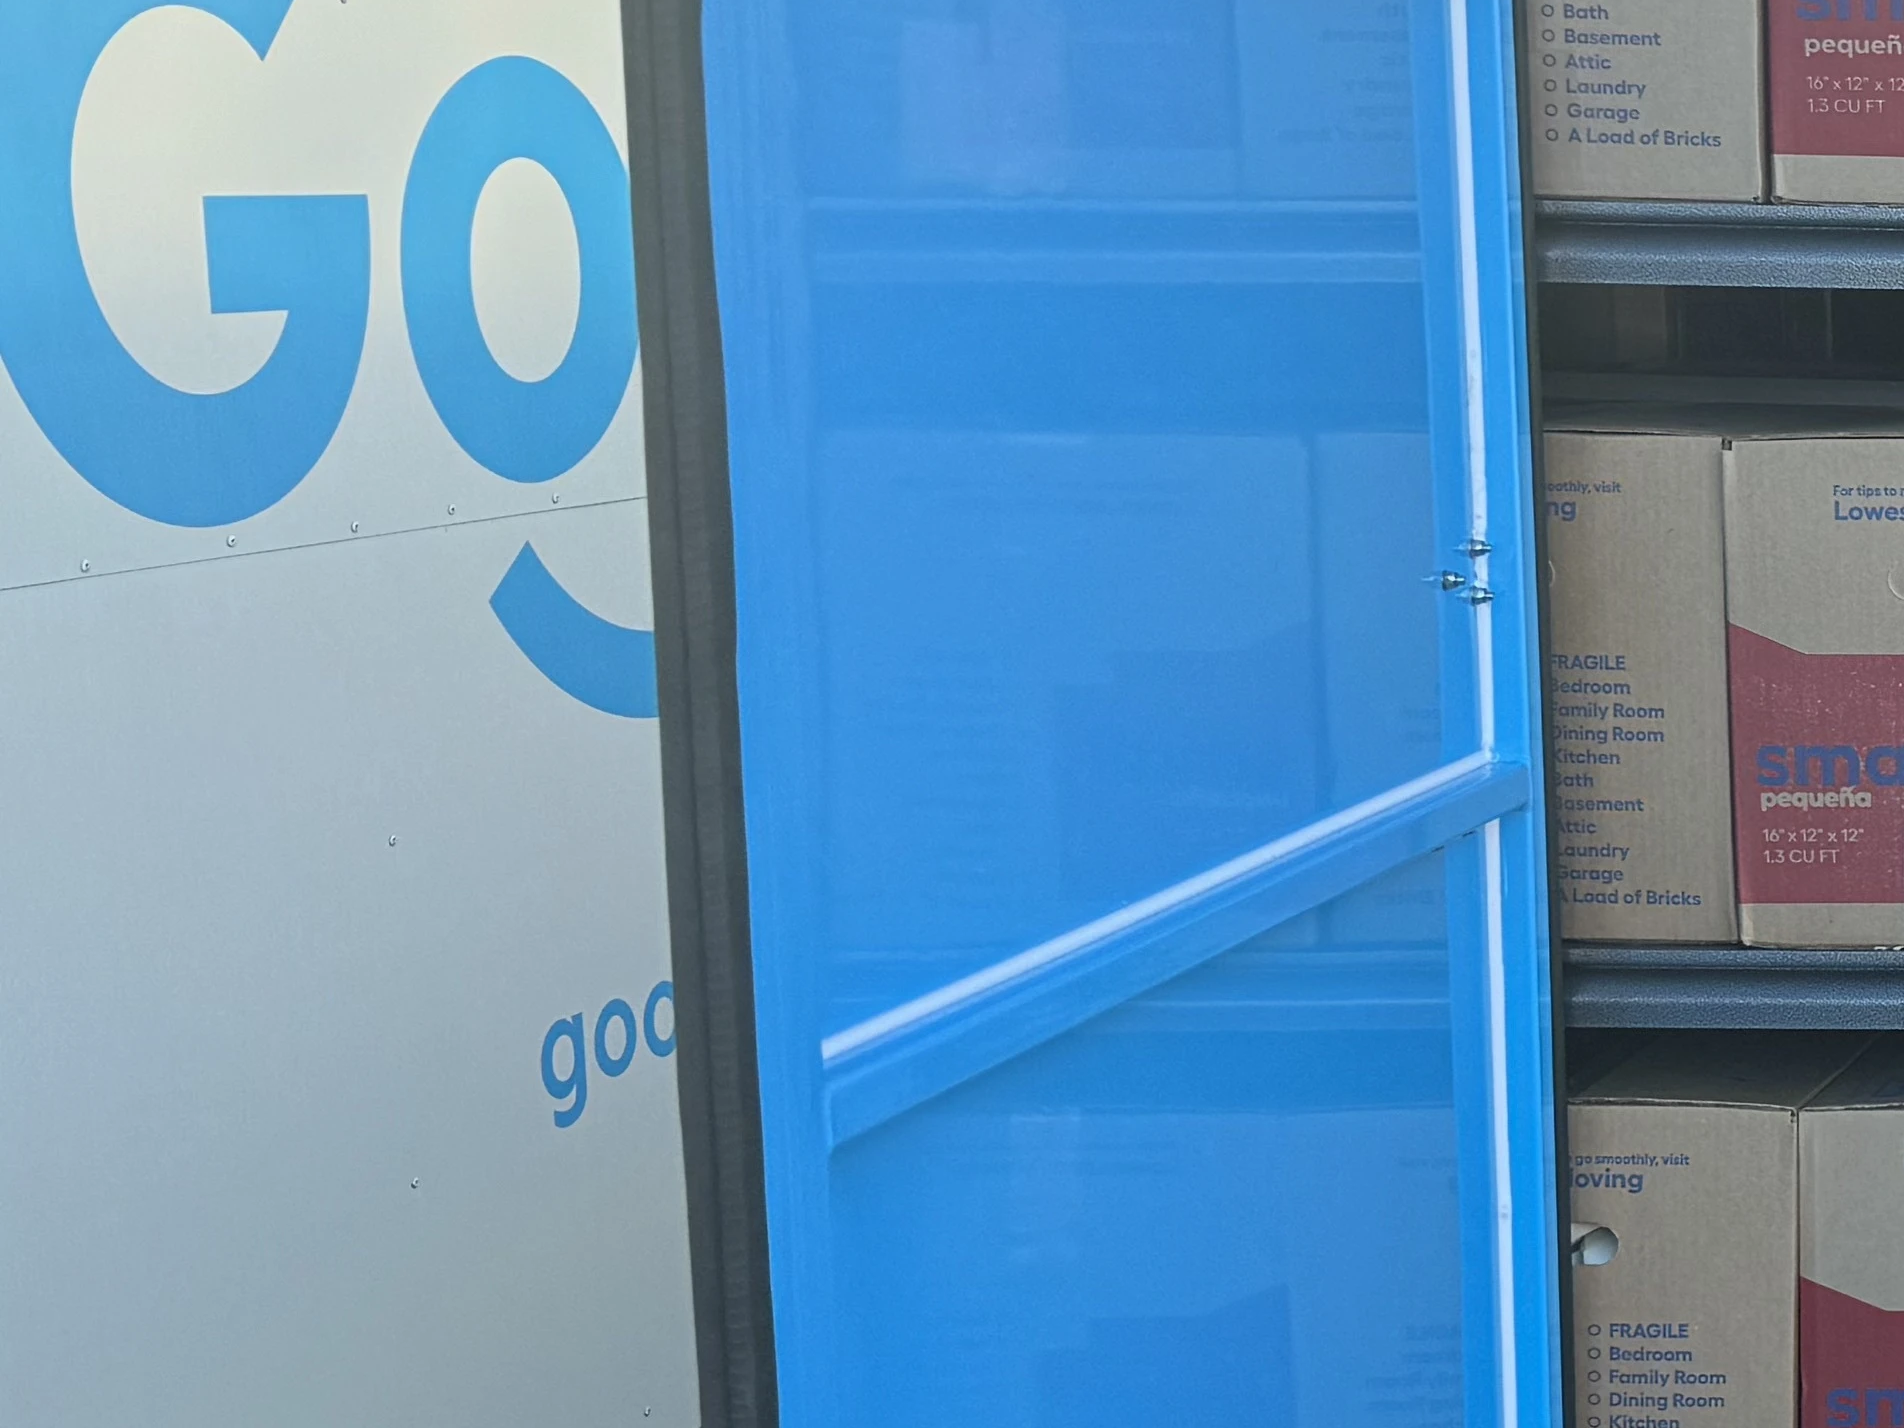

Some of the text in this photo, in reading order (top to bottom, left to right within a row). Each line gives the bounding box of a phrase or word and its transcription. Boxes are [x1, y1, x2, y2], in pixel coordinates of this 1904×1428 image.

[1833, 486, 1854, 498] For
[1857, 486, 1881, 499] tips
[1884, 486, 1897, 498] to
[1760, 787, 1872, 813] pequeña
[1762, 827, 1865, 843] 16" x 12" x 12"
[1763, 849, 1840, 864] 1.3 CU FT
